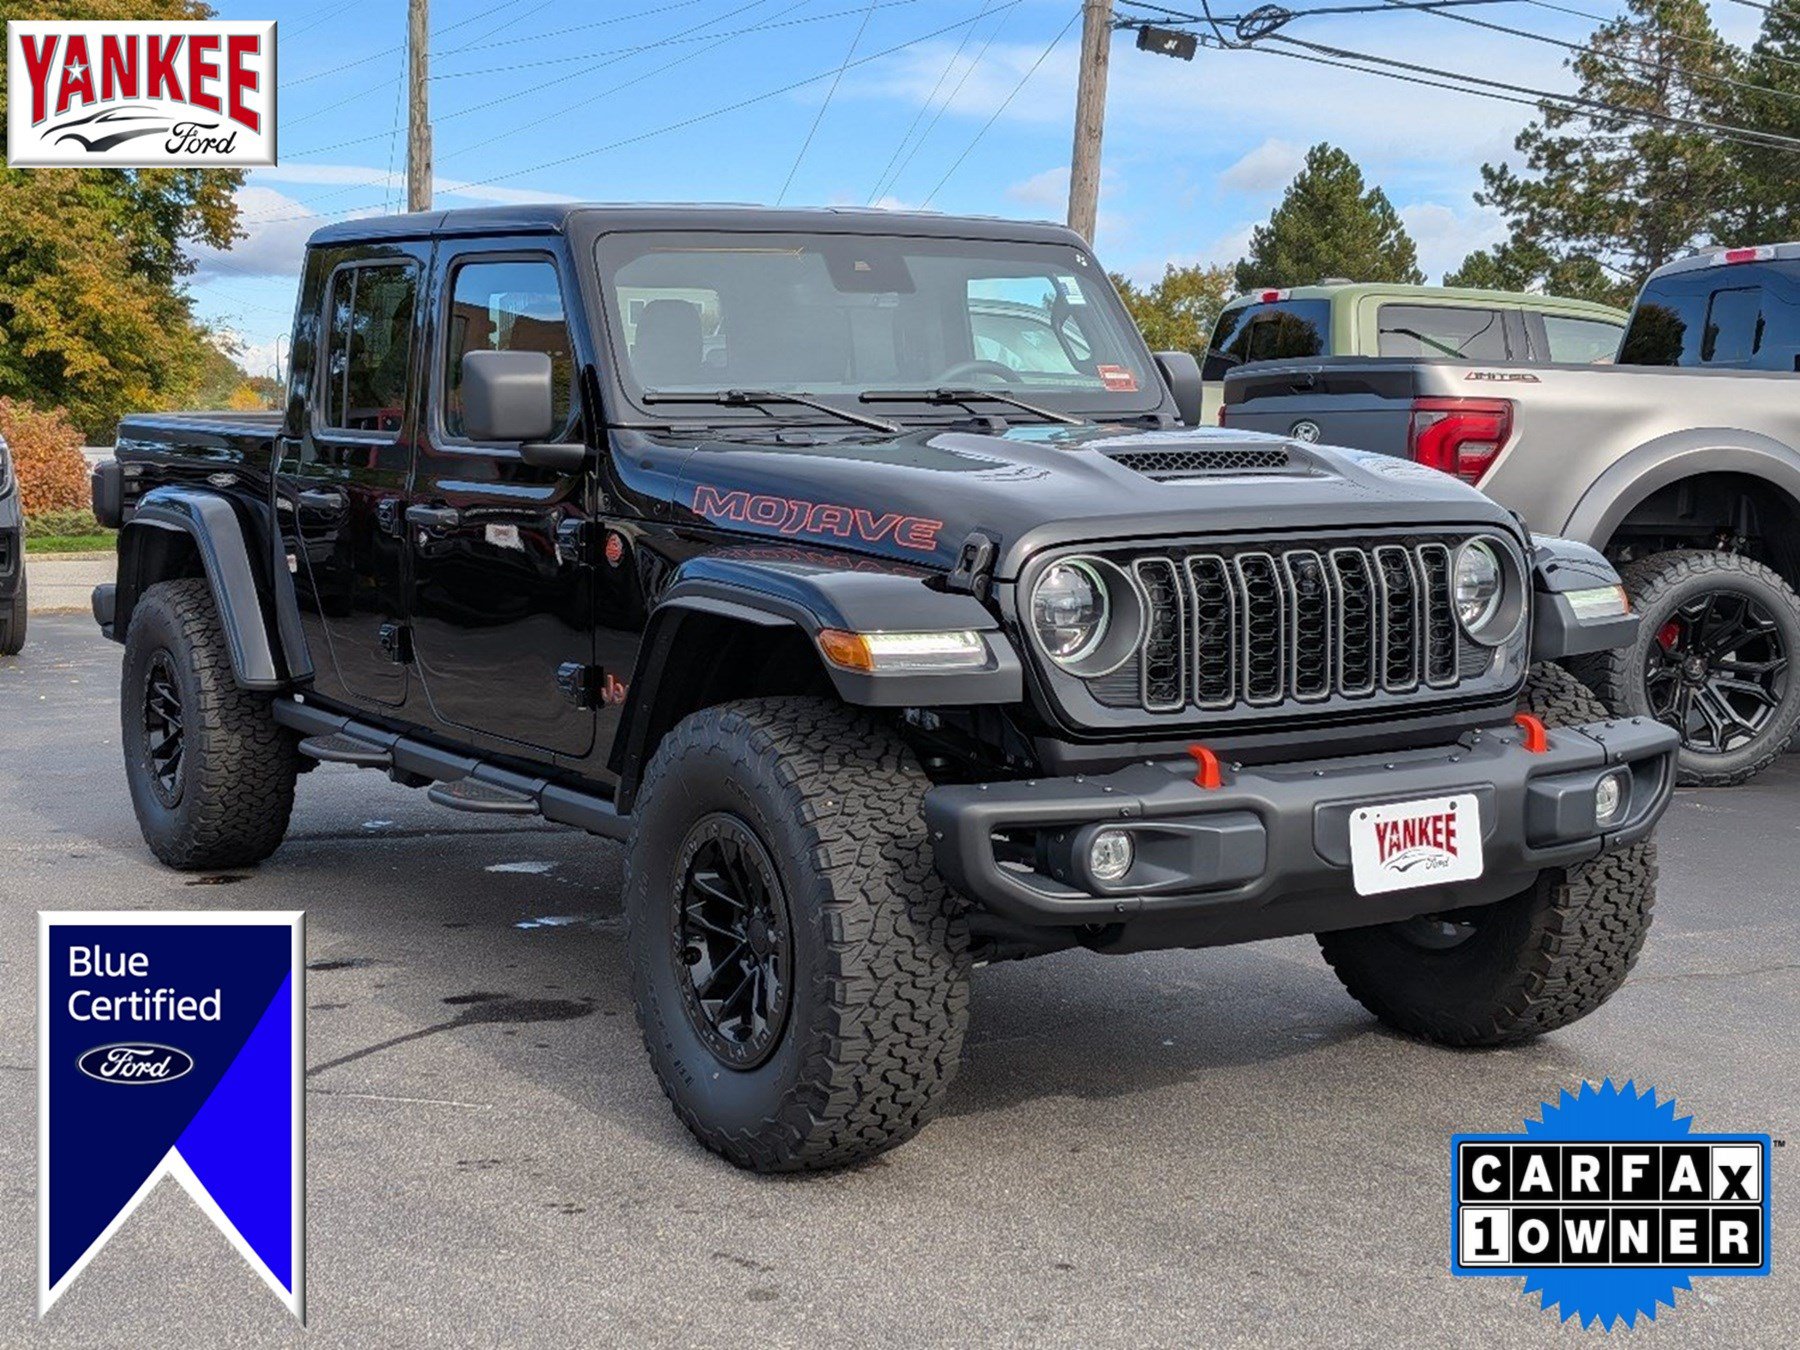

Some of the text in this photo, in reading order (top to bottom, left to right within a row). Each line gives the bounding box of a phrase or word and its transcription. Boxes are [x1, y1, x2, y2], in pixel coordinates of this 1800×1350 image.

[1464, 372, 1542, 383] LIMITED
[692, 486, 943, 550] MOJAVE
[1374, 812, 1458, 865] YANKEE
